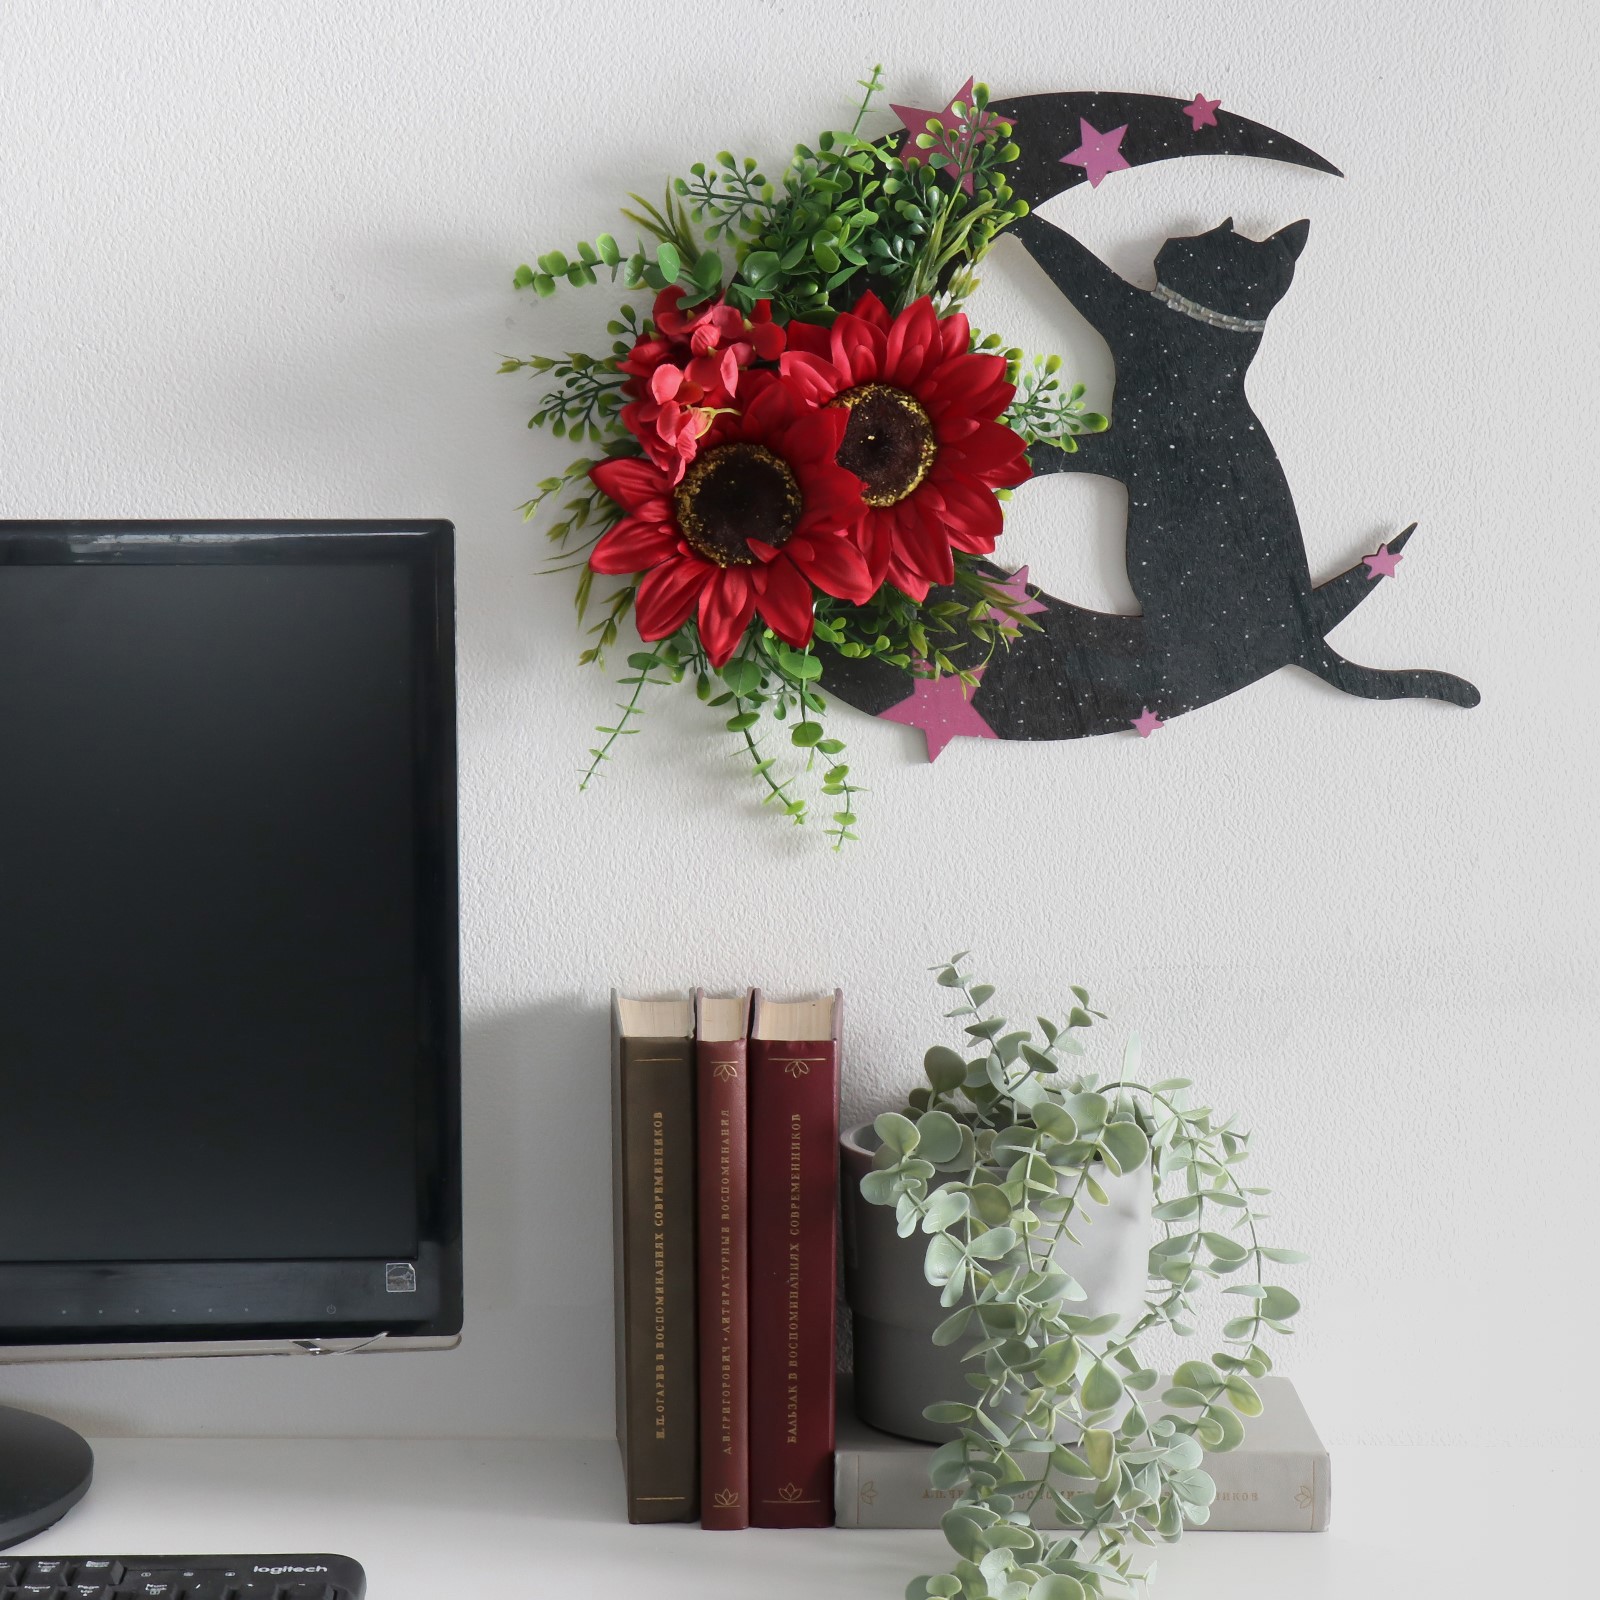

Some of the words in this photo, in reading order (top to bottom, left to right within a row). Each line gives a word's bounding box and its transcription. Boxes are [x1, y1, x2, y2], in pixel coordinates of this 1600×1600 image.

[653, 1110, 664, 1227] СОВРЕМЕННИКОВ
[720, 1109, 730, 1221] ВОСПОМИНАНИЯ
[790, 1113, 801, 1237] СОВРЕМЕННИКОВ
[654, 1232, 665, 1349] ВОСПОМИНАНИЯХ
[721, 1226, 731, 1334] ЛИТЕРАТУРНЫЕ
[788, 1242, 800, 1367] ВОСПОМИНАНИЯХ
[787, 1384, 798, 1444] БАЛЬЗАК
[788, 1372, 798, 1380] В
[253, 1565, 328, 1575] logitech
